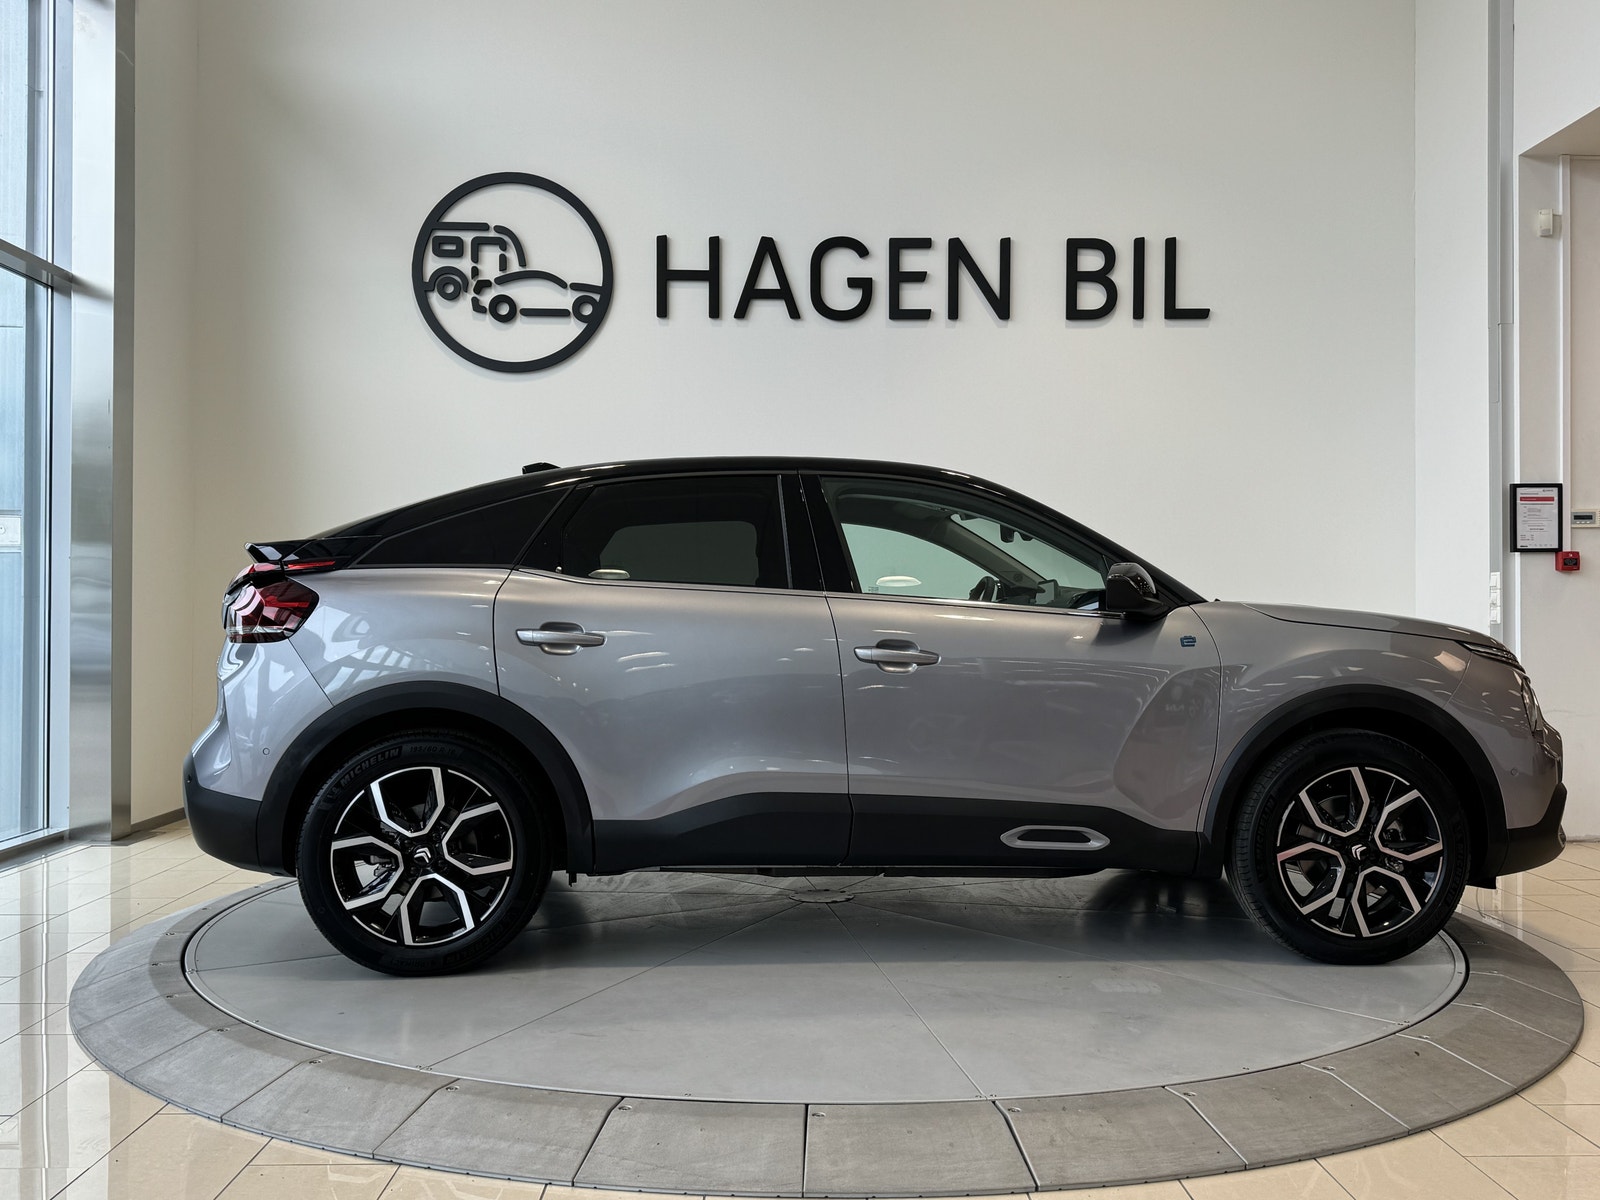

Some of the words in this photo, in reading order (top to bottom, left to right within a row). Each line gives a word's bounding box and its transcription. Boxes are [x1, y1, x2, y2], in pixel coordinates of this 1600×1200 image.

[656, 235, 1011, 322] HAGEN
[1066, 236, 1210, 321] BIL
[340, 747, 400, 787] MICHELIN
